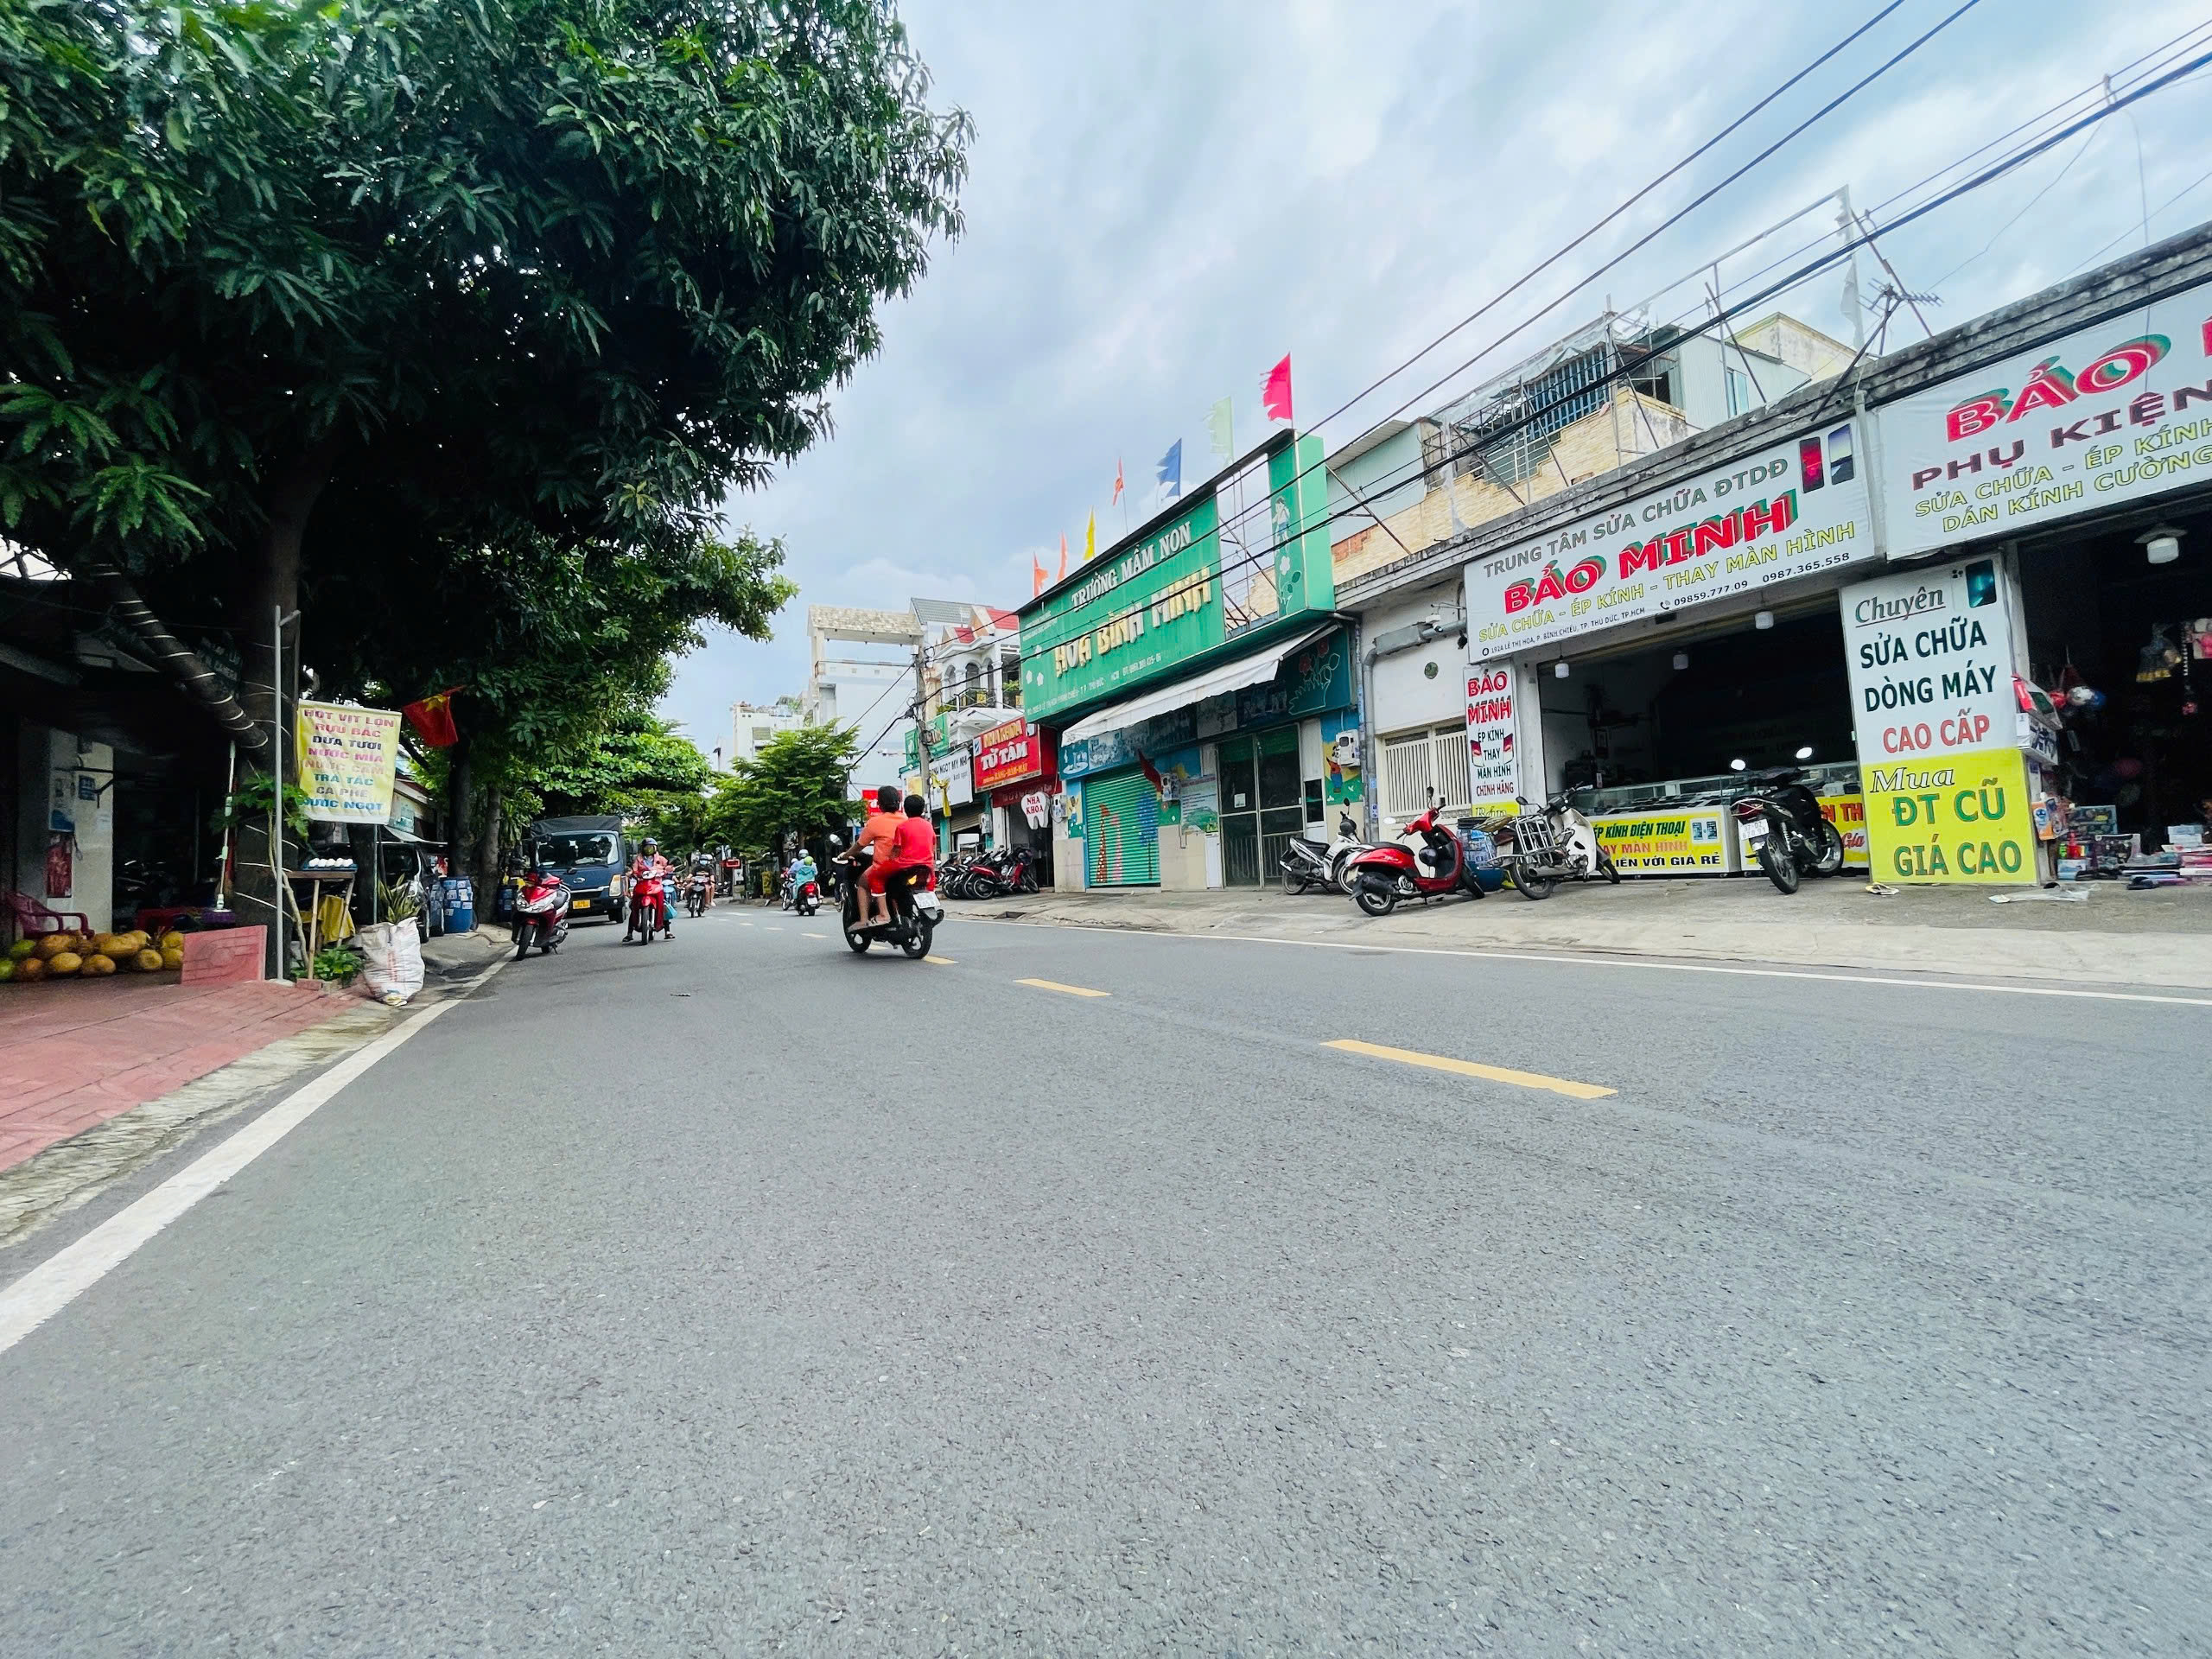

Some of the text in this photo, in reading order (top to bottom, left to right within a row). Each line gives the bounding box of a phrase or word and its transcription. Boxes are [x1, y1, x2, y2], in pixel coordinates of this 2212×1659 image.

[1945, 334, 2172, 442] BẢO
[1912, 378, 2212, 492] PHỤ KIỆN
[1914, 490, 1968, 518] SỬA
[1974, 466, 2054, 500] CHỮA
[2084, 444, 2124, 470] ÉP
[1942, 445, 2212, 533] DÁN KÍNH CƯỜNG
[1484, 458, 1789, 578] TRUNG TÂM SỬA CHỮA ĐTDĐ
[1071, 568, 1120, 613] TRƯỜNG
[1159, 521, 1192, 561] NON
[1504, 488, 1798, 614] BẢO MINH
[1478, 622, 1509, 643] SỬA
[1511, 608, 1555, 633] CHỮA
[1570, 597, 1592, 618] ÉP
[1597, 583, 1644, 610] KÍNH
[1663, 561, 1719, 590] THAY
[1726, 545, 1777, 574] MÀN
[1786, 521, 1855, 556] HÌNH
[1673, 552, 1851, 607] 09859.777.09 0987.365.558
[1096, 601, 1145, 656] BÌNH
[1151, 567, 1211, 629] MINH
[1854, 586, 1945, 621] Chuyên
[1859, 615, 1988, 670] SỬA CHỮA
[1467, 669, 1509, 697] BẢO
[1864, 659, 1998, 713] DÒNG MÁY
[1467, 696, 1513, 726] MINH
[1478, 726, 1505, 743] ÉP KÍNH
[1882, 722, 1933, 754] CAO
[999, 741, 1028, 765] TÂM
[1483, 747, 1501, 761] THAY
[1493, 761, 1512, 778] HÌNH
[1476, 781, 1497, 797] CHÍNH
[1869, 766, 1956, 794] Mua
[1026, 804, 1044, 815] KHOA
[1027, 795, 1040, 804] NHA
[1891, 777, 2007, 827] ĐT CŨ
[1605, 823, 1630, 838] KÍNH
[1630, 821, 1654, 839] ĐIỆN
[1656, 820, 1686, 836] THOẠI
[1603, 844, 1618, 855] AY
[1643, 855, 1666, 867] VỚI
[1670, 854, 1696, 866] GIÁ
[1700, 852, 1720, 865] RẺ
[1893, 833, 2023, 877] GIÁ CAO
